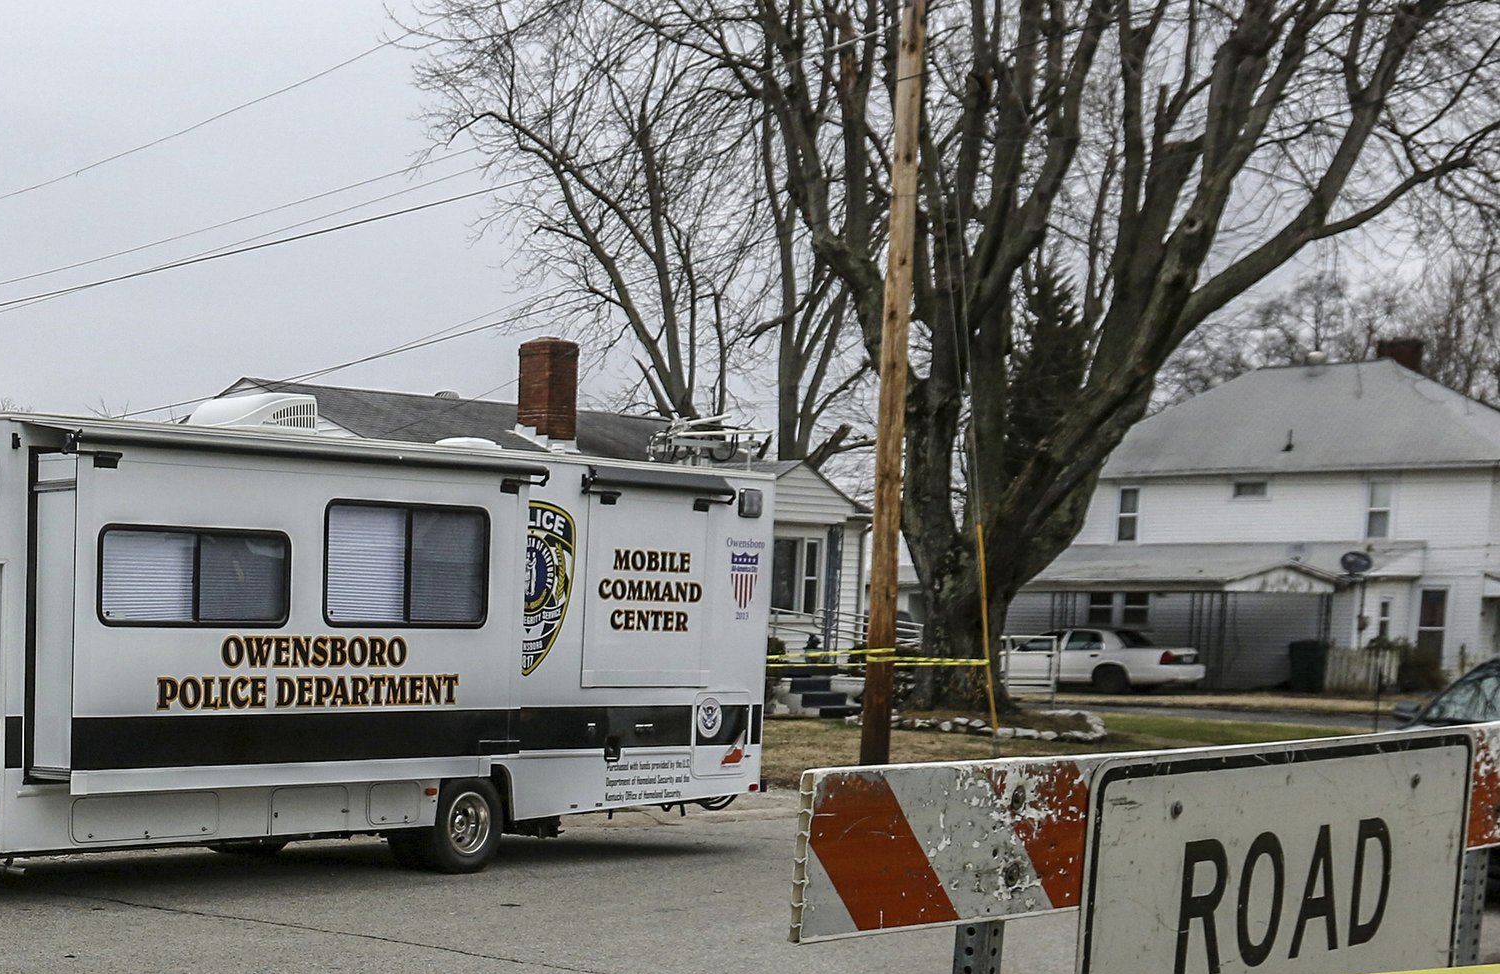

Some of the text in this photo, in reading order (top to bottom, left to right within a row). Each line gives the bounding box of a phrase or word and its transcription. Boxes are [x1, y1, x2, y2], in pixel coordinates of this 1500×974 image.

[613, 549, 691, 573] MOBILE
[598, 578, 702, 603] COMMAND
[610, 609, 688, 632] CENTER
[220, 635, 407, 668] OWENSBORO
[156, 674, 459, 711] POLICE DEPARTMENT
